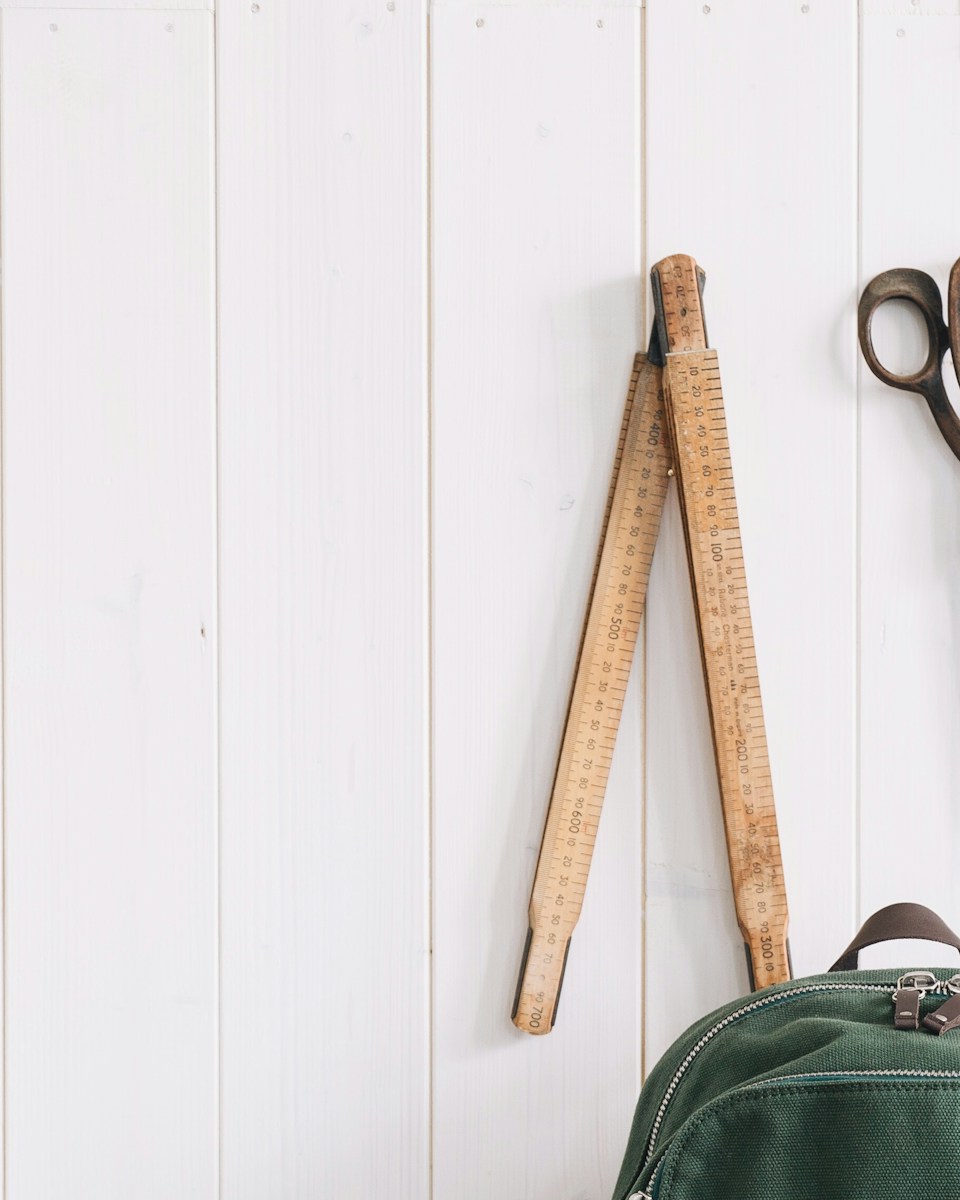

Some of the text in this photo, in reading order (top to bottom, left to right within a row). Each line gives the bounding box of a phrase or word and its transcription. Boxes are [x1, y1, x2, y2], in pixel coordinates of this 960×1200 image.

[676, 286, 685, 298] 70
[689, 366, 698, 376] 10
[692, 385, 701, 398] 20
[653, 409, 663, 420] 90
[694, 405, 704, 417] 30
[647, 423, 660, 445] 400
[697, 424, 707, 437] 40
[645, 449, 655, 459] 10
[699, 445, 708, 458] 50
[641, 467, 651, 479] 20
[702, 464, 711, 477] 60
[637, 486, 647, 498] 30
[705, 485, 714, 497] 70
[634, 505, 643, 518] 40
[707, 504, 716, 517] 80
[629, 526, 640, 537] 50
[709, 524, 718, 537] 90
[626, 544, 636, 557] 60
[711, 543, 723, 562] 100
[622, 564, 632, 576] 70
[618, 583, 628, 595] 80
[614, 603, 623, 615] 90
[608, 617, 622, 640] 500
[606, 643, 615, 652] 10
[602, 661, 612, 673] 20
[598, 681, 608, 692] 30
[594, 700, 603, 712] 40
[590, 720, 600, 731] 50
[587, 738, 596, 750] 60
[736, 739, 748, 761] 200
[583, 759, 593, 770] 70
[740, 765, 749, 774] 10
[578, 778, 588, 789] 80
[742, 784, 752, 795] 20
[574, 797, 584, 809] 90
[745, 803, 754, 815] 30
[569, 810, 582, 834] 600
[748, 822, 757, 834] 40
[567, 838, 576, 847] 10
[563, 856, 572, 868] 20
[752, 862, 762, 874] 60
[558, 875, 568, 887] 30
[754, 882, 764, 894] 70
[555, 894, 564, 906] 40
[757, 901, 766, 914] 80
[551, 914, 560, 925] 50
[760, 921, 769, 933] 90
[547, 933, 557, 944] 60
[761, 936, 774, 959] 300
[544, 953, 553, 964] 70
[765, 962, 774, 972] 10
[535, 992, 544, 1003] 90
[529, 1006, 544, 1028] 700
